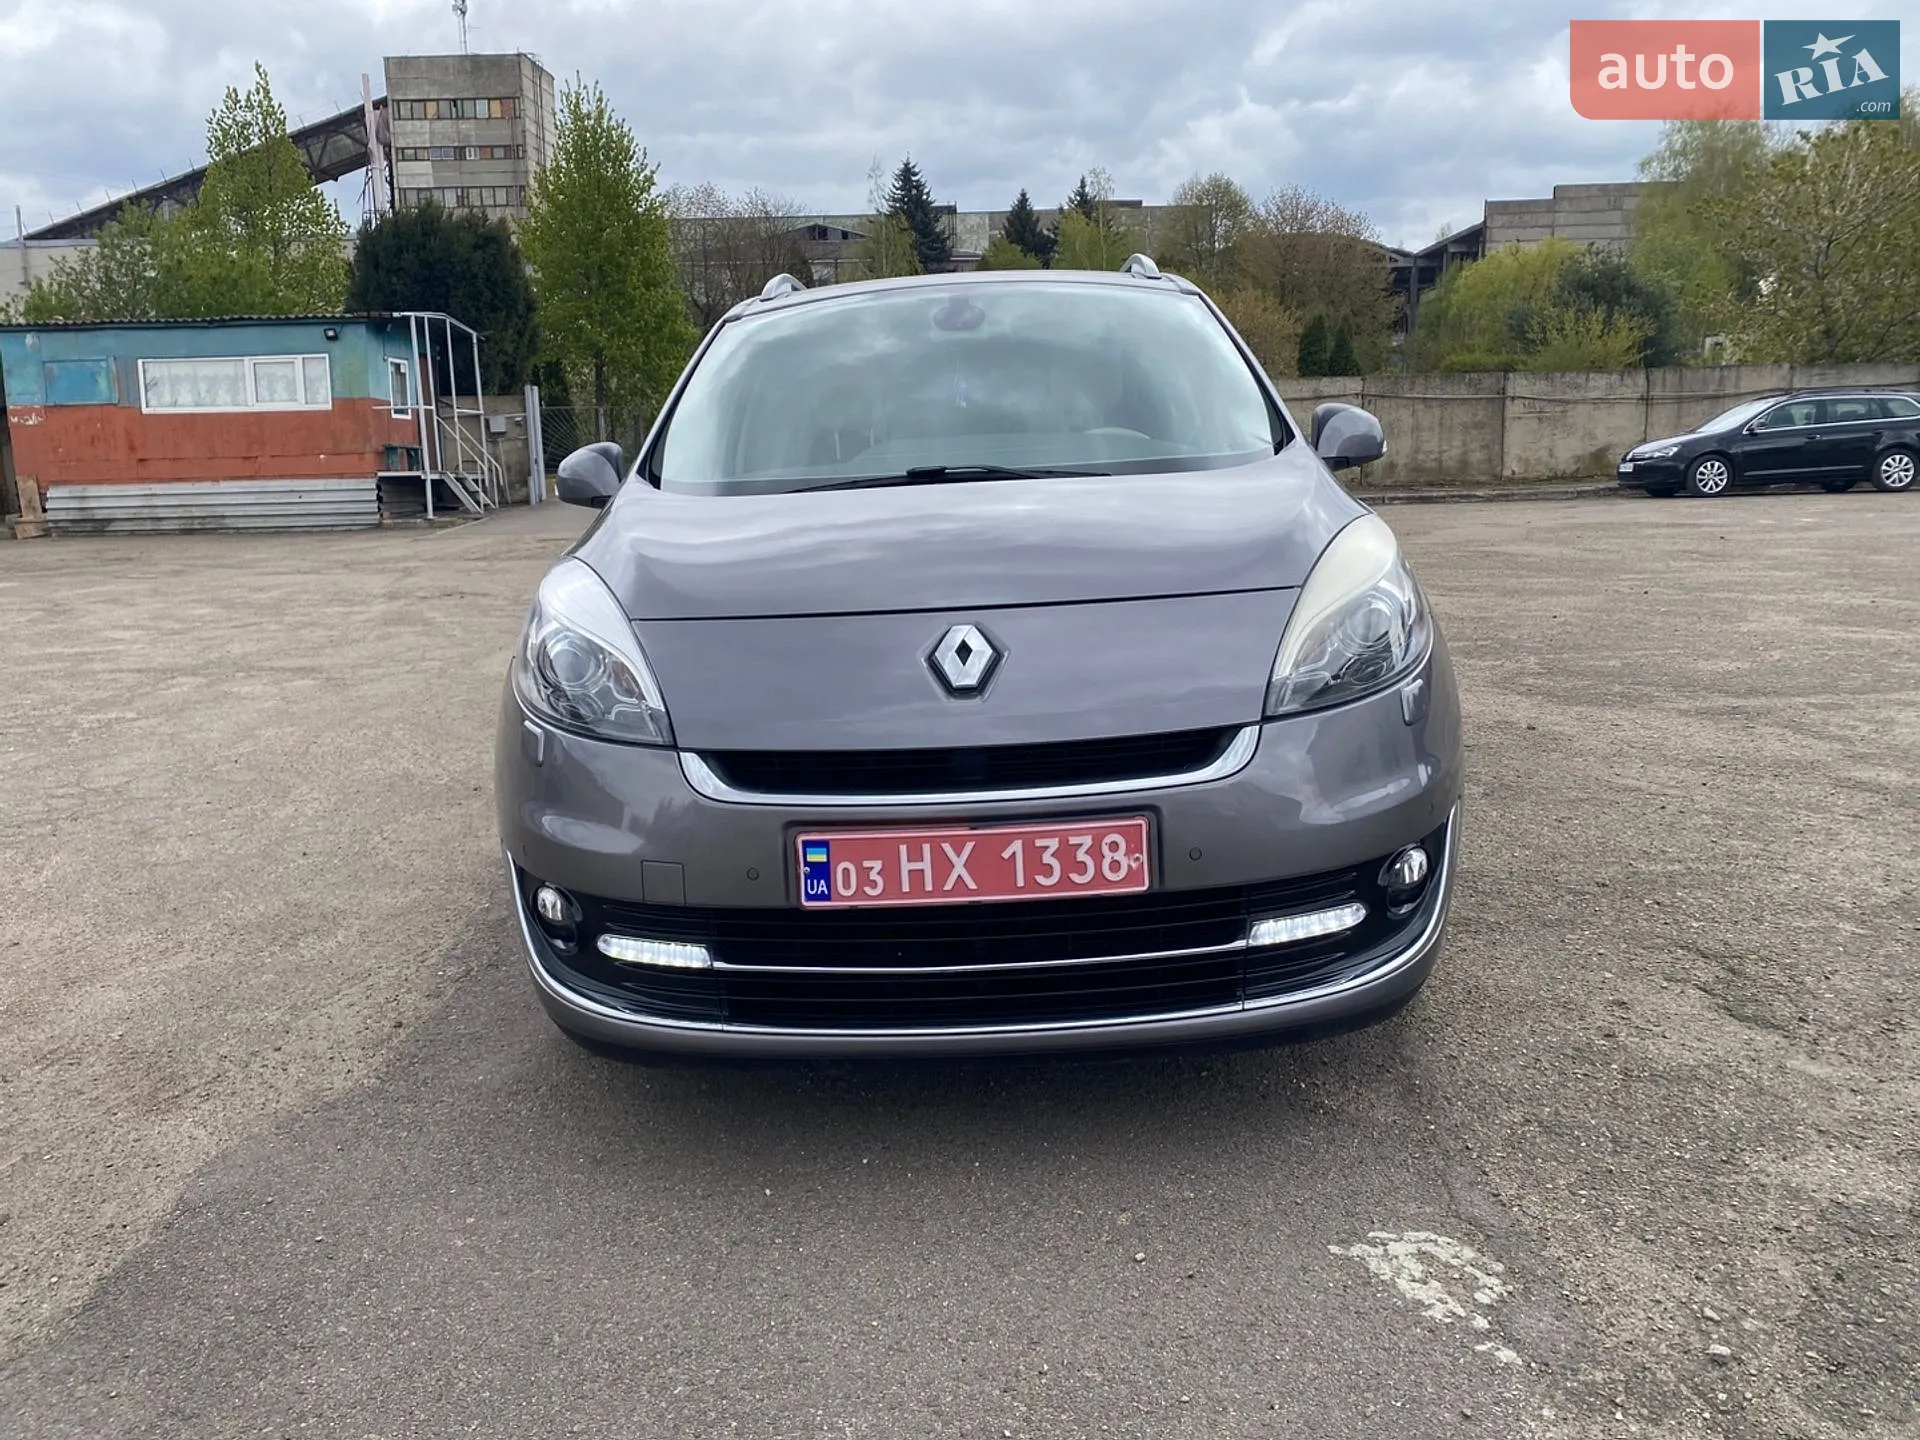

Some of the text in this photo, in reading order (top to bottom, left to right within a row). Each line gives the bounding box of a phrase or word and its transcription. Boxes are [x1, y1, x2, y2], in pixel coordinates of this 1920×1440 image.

[835, 833, 1129, 897] 03 HX 1338
[807, 879, 829, 896] UA
